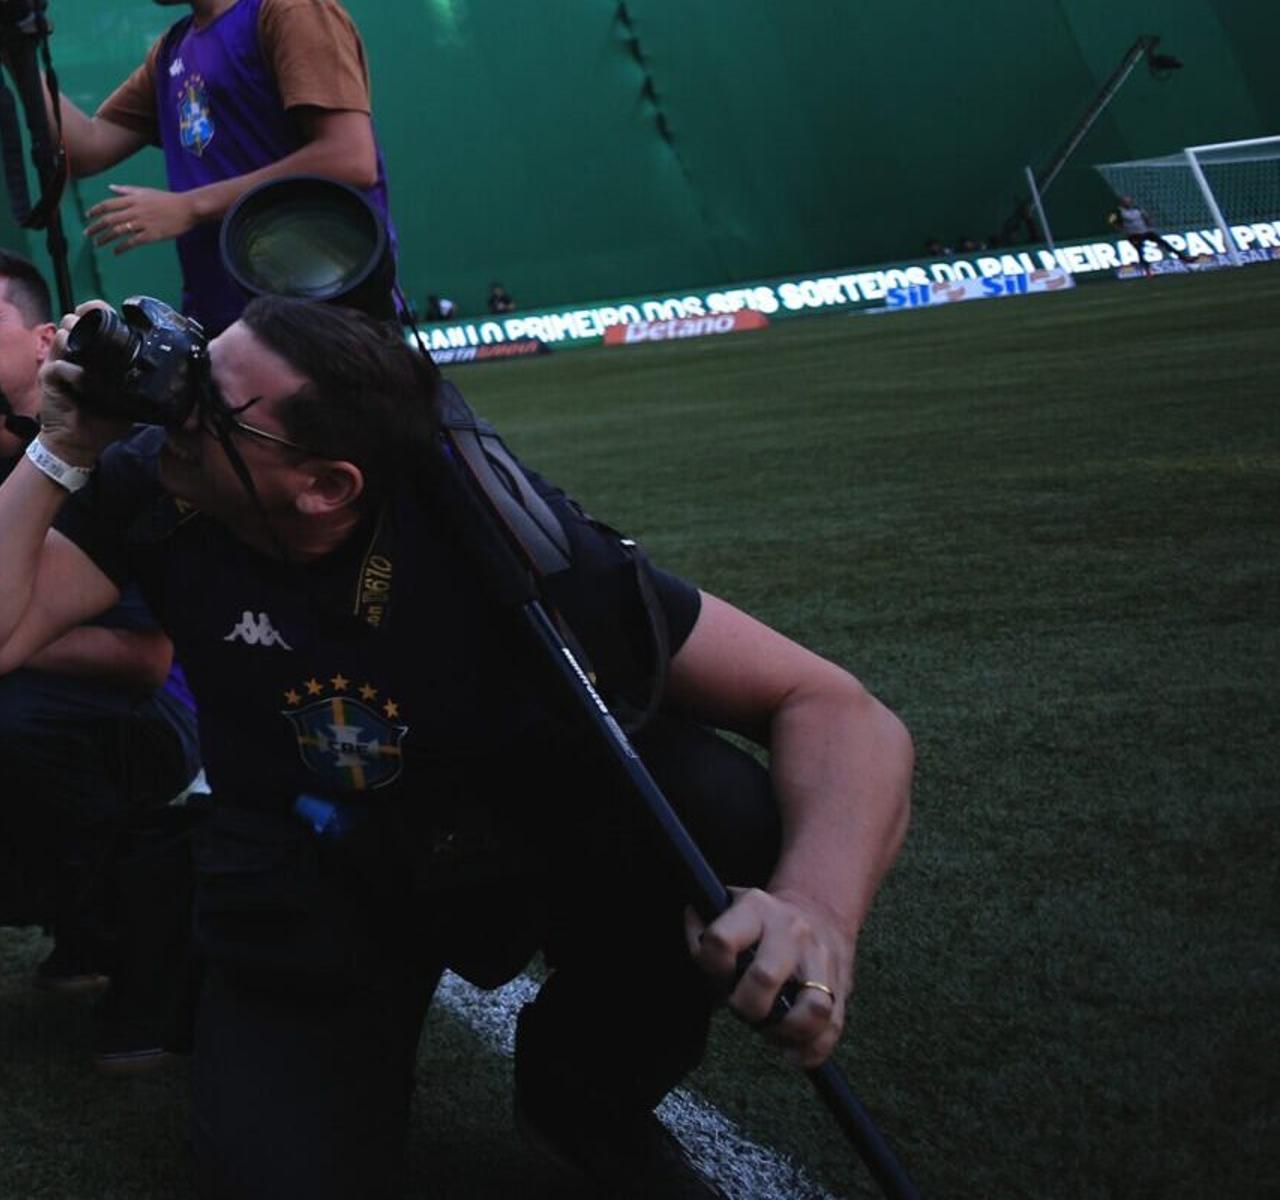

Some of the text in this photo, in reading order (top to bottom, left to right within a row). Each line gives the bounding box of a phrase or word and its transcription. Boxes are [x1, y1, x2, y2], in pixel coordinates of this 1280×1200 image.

[504, 304, 641, 343] PRIMEIRO
[777, 266, 929, 311] SORTEIOS
[976, 238, 1163, 279] PALMEIRAS
[886, 284, 930, 308] Sil
[980, 273, 1028, 298] Sil
